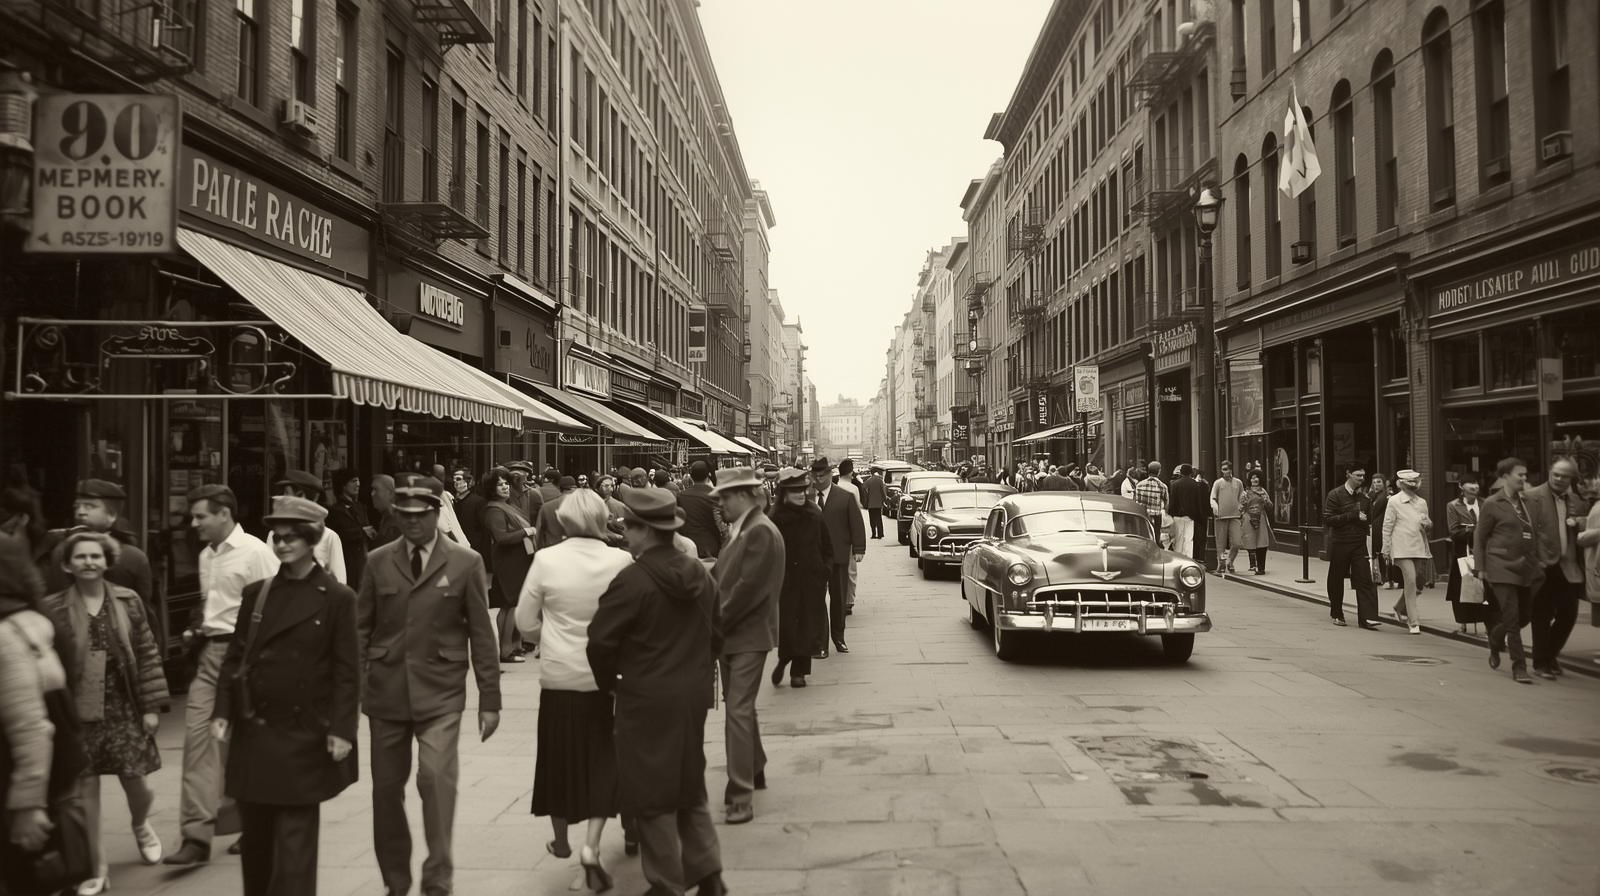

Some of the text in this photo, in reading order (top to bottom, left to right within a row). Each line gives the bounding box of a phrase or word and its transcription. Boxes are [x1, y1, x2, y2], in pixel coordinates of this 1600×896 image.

[57, 195, 147, 220] BOOK
[189, 158, 332, 259] PAILE RACKE
